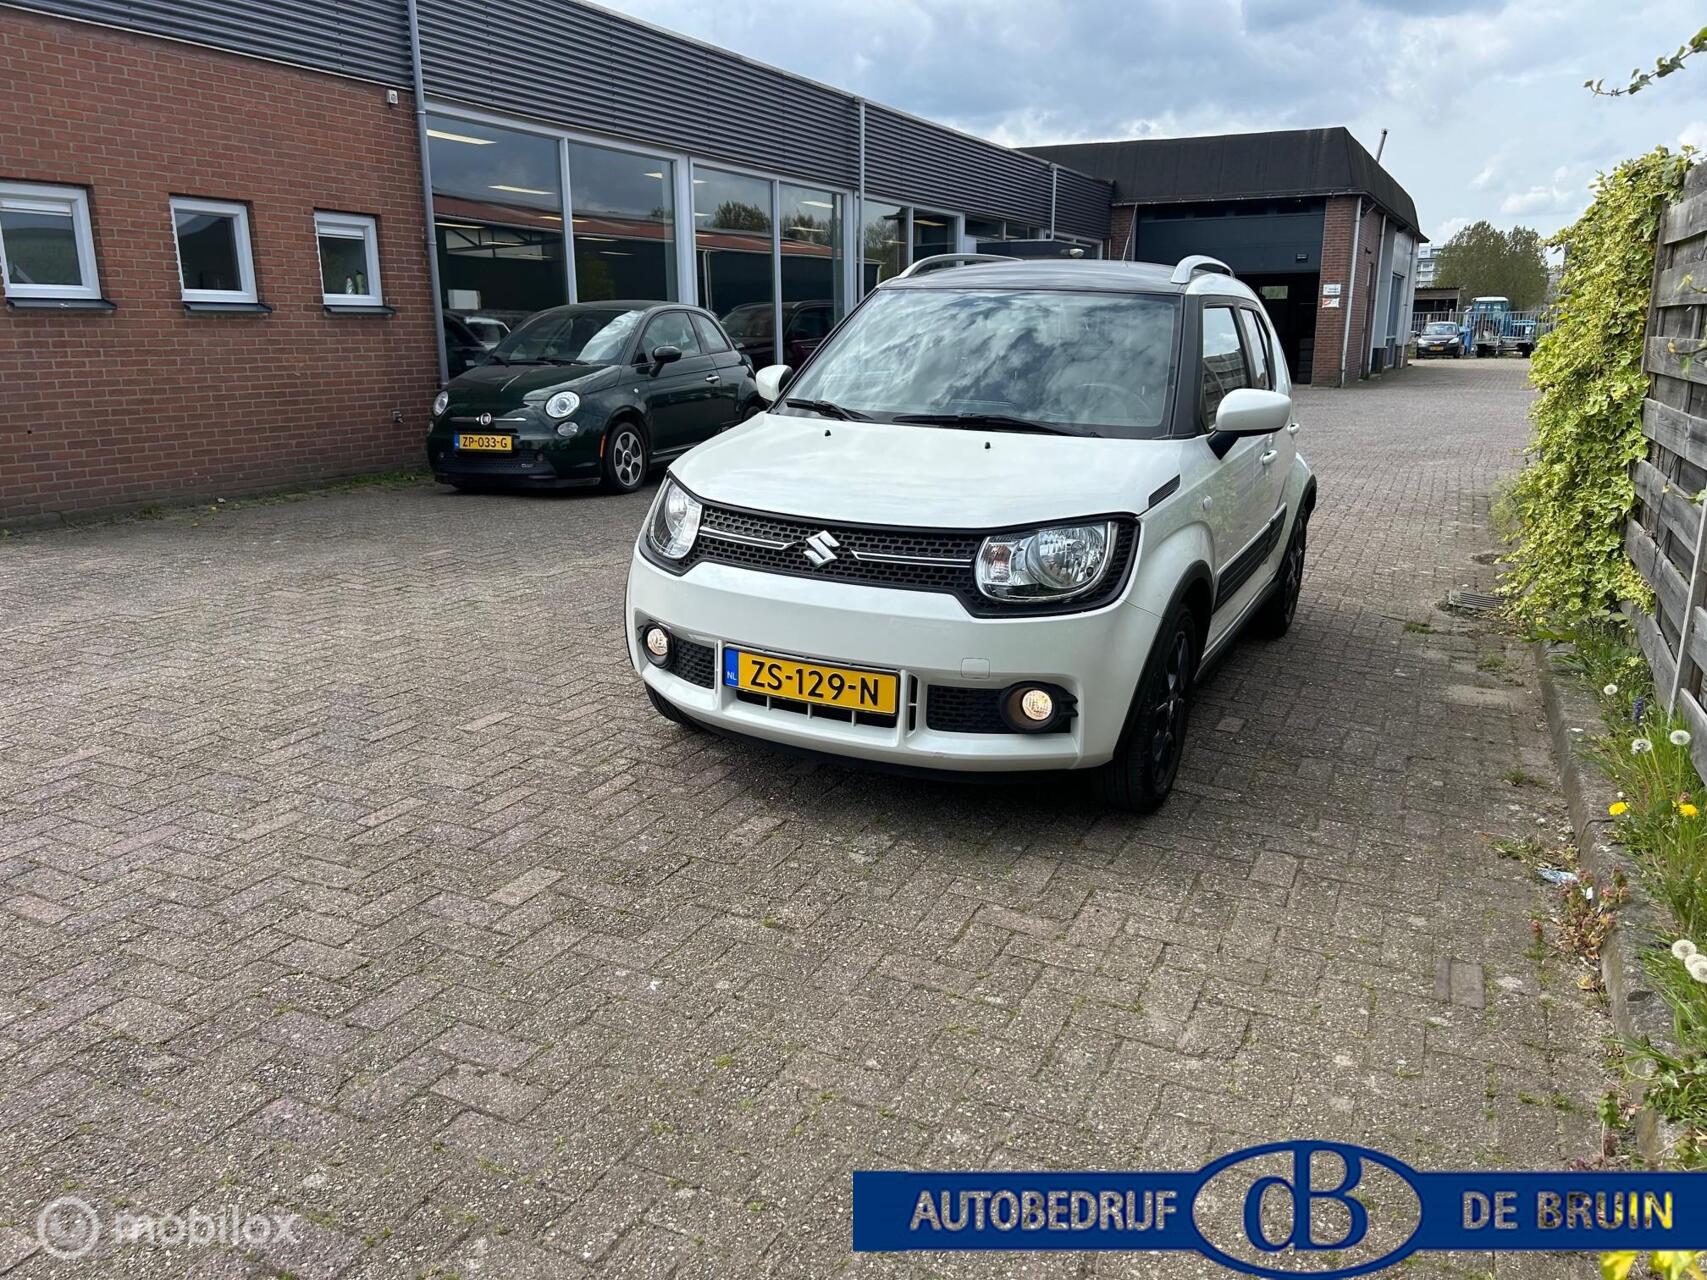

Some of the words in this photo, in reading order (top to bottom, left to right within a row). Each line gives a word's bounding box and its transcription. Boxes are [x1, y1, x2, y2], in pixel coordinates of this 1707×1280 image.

[462, 436, 507, 448] ZP-033-G
[726, 671, 737, 681] NL
[750, 660, 879, 706] ZS-129-N
